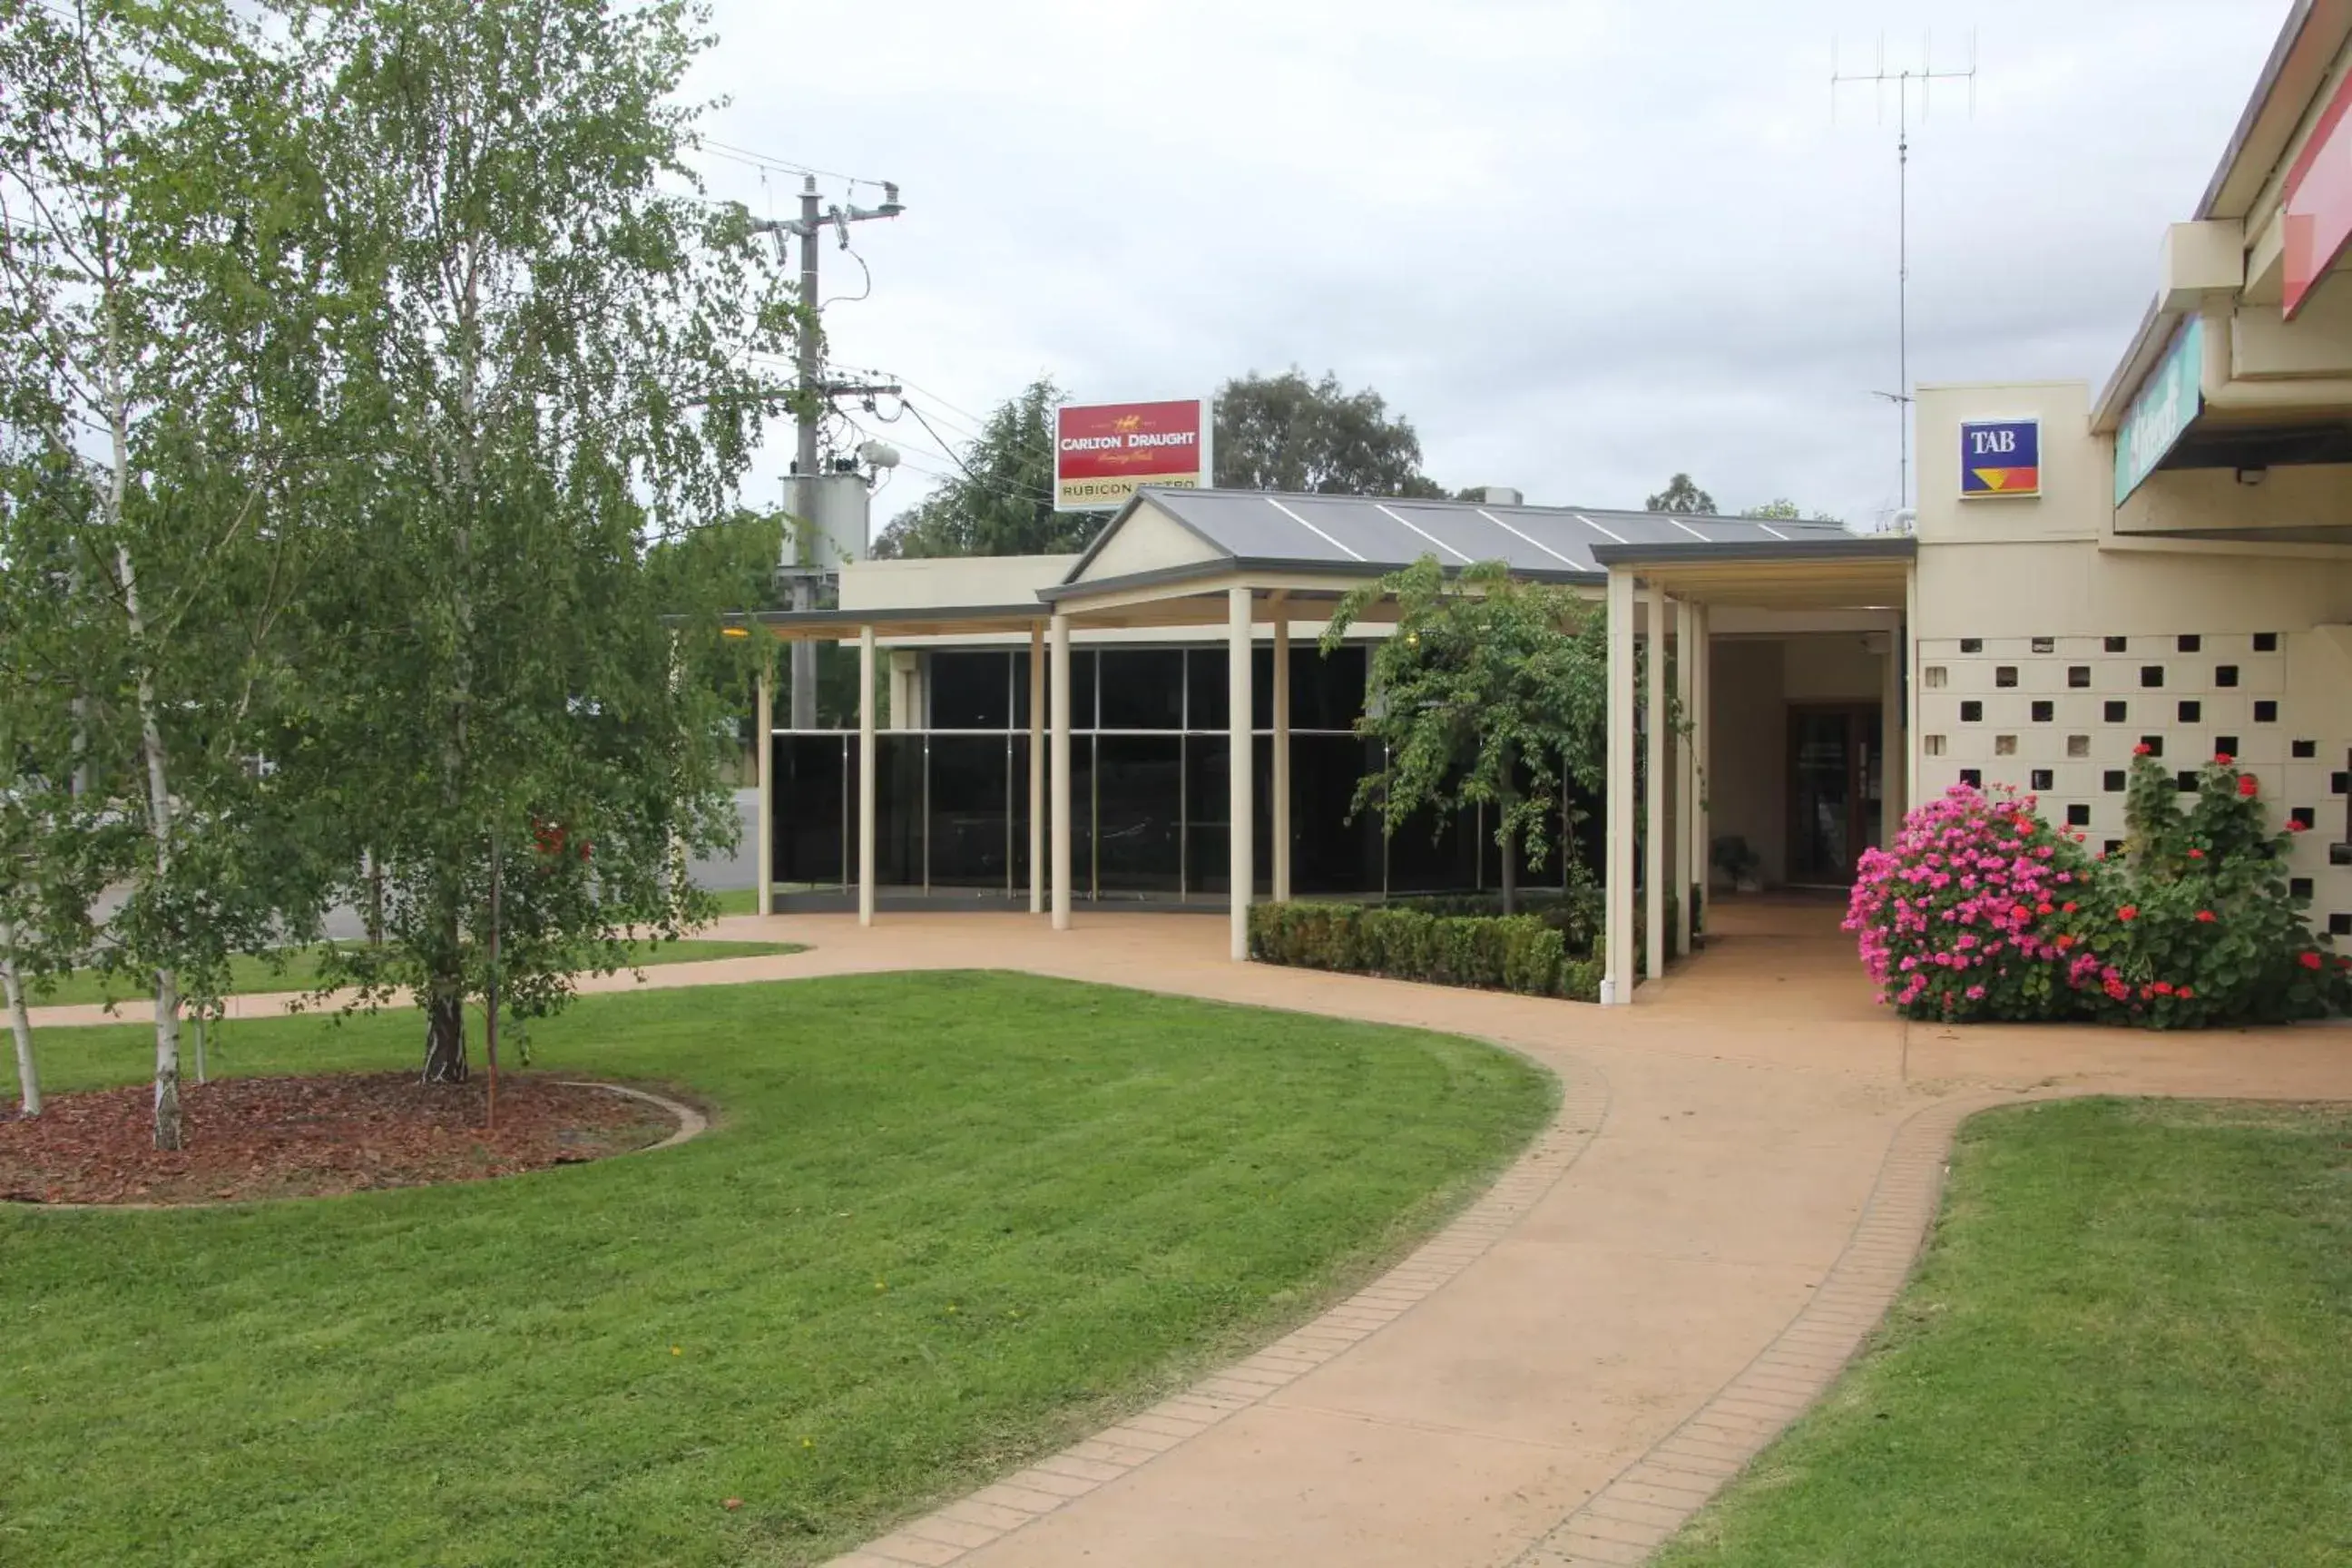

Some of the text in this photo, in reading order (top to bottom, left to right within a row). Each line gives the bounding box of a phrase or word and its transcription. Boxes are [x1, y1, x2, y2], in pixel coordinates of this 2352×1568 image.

[1061, 432, 1195, 450] CARLTON DRAUGHT
[1971, 430, 2015, 454] TAB
[1063, 480, 1195, 496] RUBICON TRO
